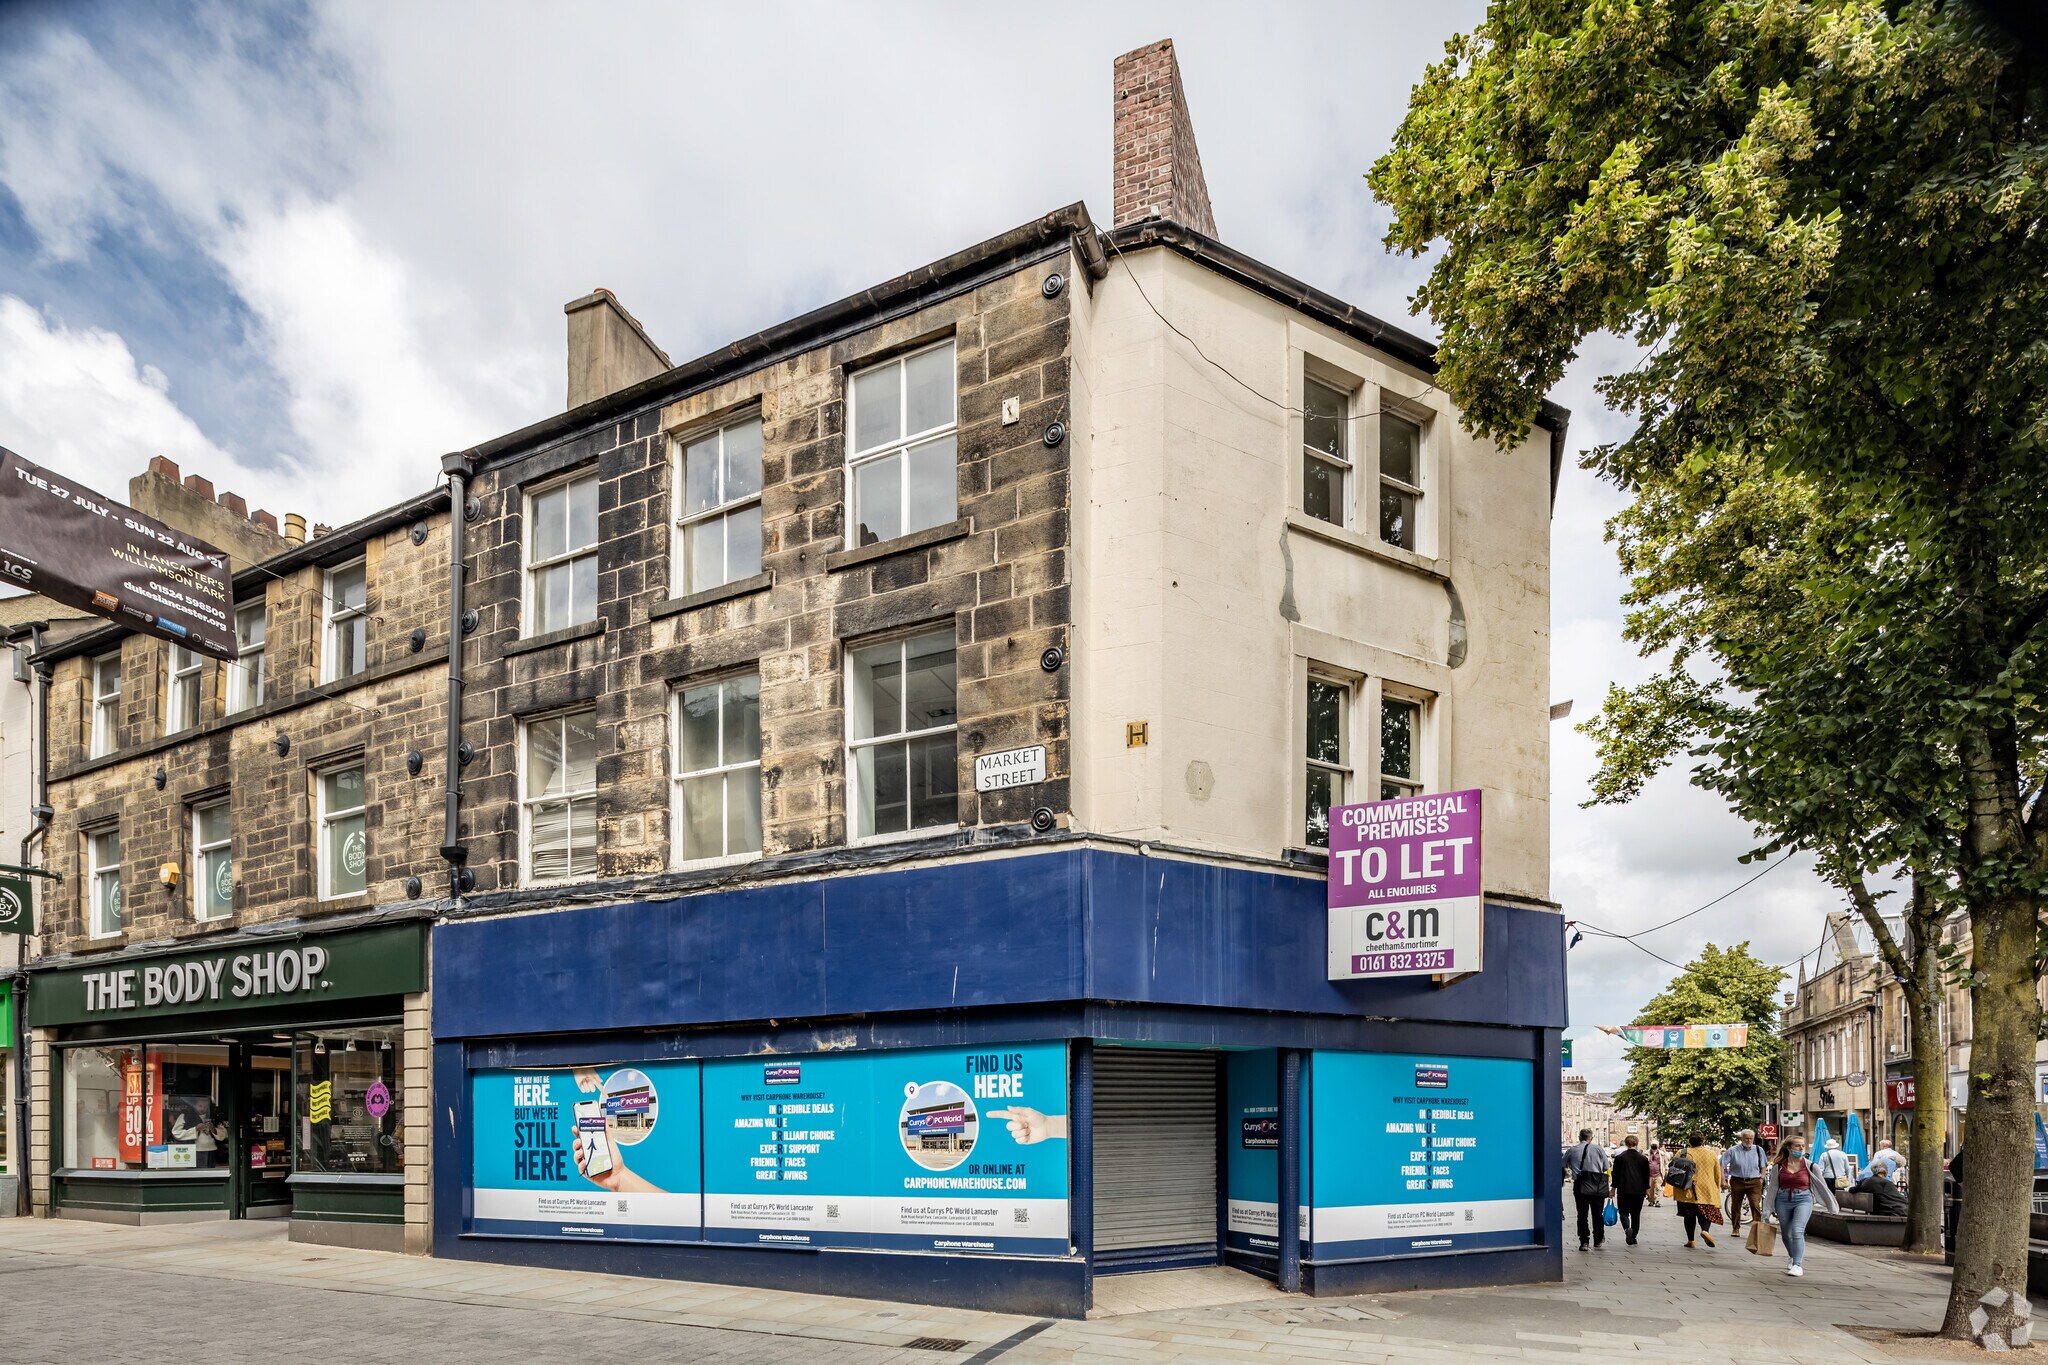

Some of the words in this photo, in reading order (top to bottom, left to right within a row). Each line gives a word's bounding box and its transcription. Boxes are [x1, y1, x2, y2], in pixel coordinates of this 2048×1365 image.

[15, 466, 48, 490] TUE
[50, 484, 70, 498] 27
[73, 496, 108, 517] JULY
[124, 518, 154, 538] SUN
[158, 533, 174, 547] 22
[176, 542, 204, 560] AUG
[127, 543, 139, 555] IN
[144, 550, 224, 590] LANCASTER'S
[111, 547, 192, 587] WILLIAMSON
[196, 582, 225, 602] PARK
[124, 582, 226, 631] dukeslancaster.org
[150, 582, 183, 600] 01524
[186, 595, 225, 619] 598500
[980, 749, 1039, 770] MARKET
[985, 768, 1036, 788] STREET
[1342, 796, 1467, 826] COMMERCIAL
[1358, 815, 1449, 842] PREMISES
[1336, 847, 1388, 885] TO
[1401, 837, 1472, 880] LET
[1368, 889, 1385, 899] ALL
[1387, 884, 1437, 896] ENQUIRIES
[1366, 908, 1439, 941] c&m
[1366, 940, 1438, 951] cheetham&mortimer
[1360, 956, 1385, 971] 0161
[1390, 955, 1411, 969] 832
[1416, 952, 1445, 967] 3375
[82, 970, 136, 1011] THE
[144, 958, 226, 1006] BODY
[966, 1055, 998, 1073] FIND
[1004, 1054, 1022, 1072] US
[129, 1074, 151, 1093] SAE
[974, 1074, 1023, 1098] HERE
[126, 1096, 138, 1104] UP
[514, 1084, 558, 1106] HERE...
[793, 1092, 825, 1100] WAREHOUSE?
[515, 1108, 531, 1120] BUT
[532, 1108, 558, 1120] WE'RE
[812, 1104, 834, 1113] DEALS
[1458, 1111, 1474, 1120] DEALS
[735, 1119, 763, 1128] AMAZING
[1244, 1123, 1261, 1131] Currys
[1386, 1123, 1414, 1133] AMAZING
[515, 1122, 560, 1148] STILL
[810, 1131, 835, 1140] CHOICE
[789, 1144, 820, 1153] SUPPORT
[1456, 1138, 1476, 1147] CHOICE
[785, 1158, 806, 1166] FACES
[1437, 1152, 1464, 1161] SUPPORT
[515, 1150, 568, 1181] HERE
[969, 1164, 980, 1174] OR
[983, 1164, 1013, 1174] ONLINE
[1015, 1164, 1025, 1174] AT
[1433, 1166, 1449, 1175] FACES
[756, 1171, 776, 1180] GREAT
[904, 1178, 1026, 1189] CARPHONEWAREHOUSE.COM
[1406, 1180, 1426, 1190] GREAT
[927, 1207, 944, 1215] Currys
